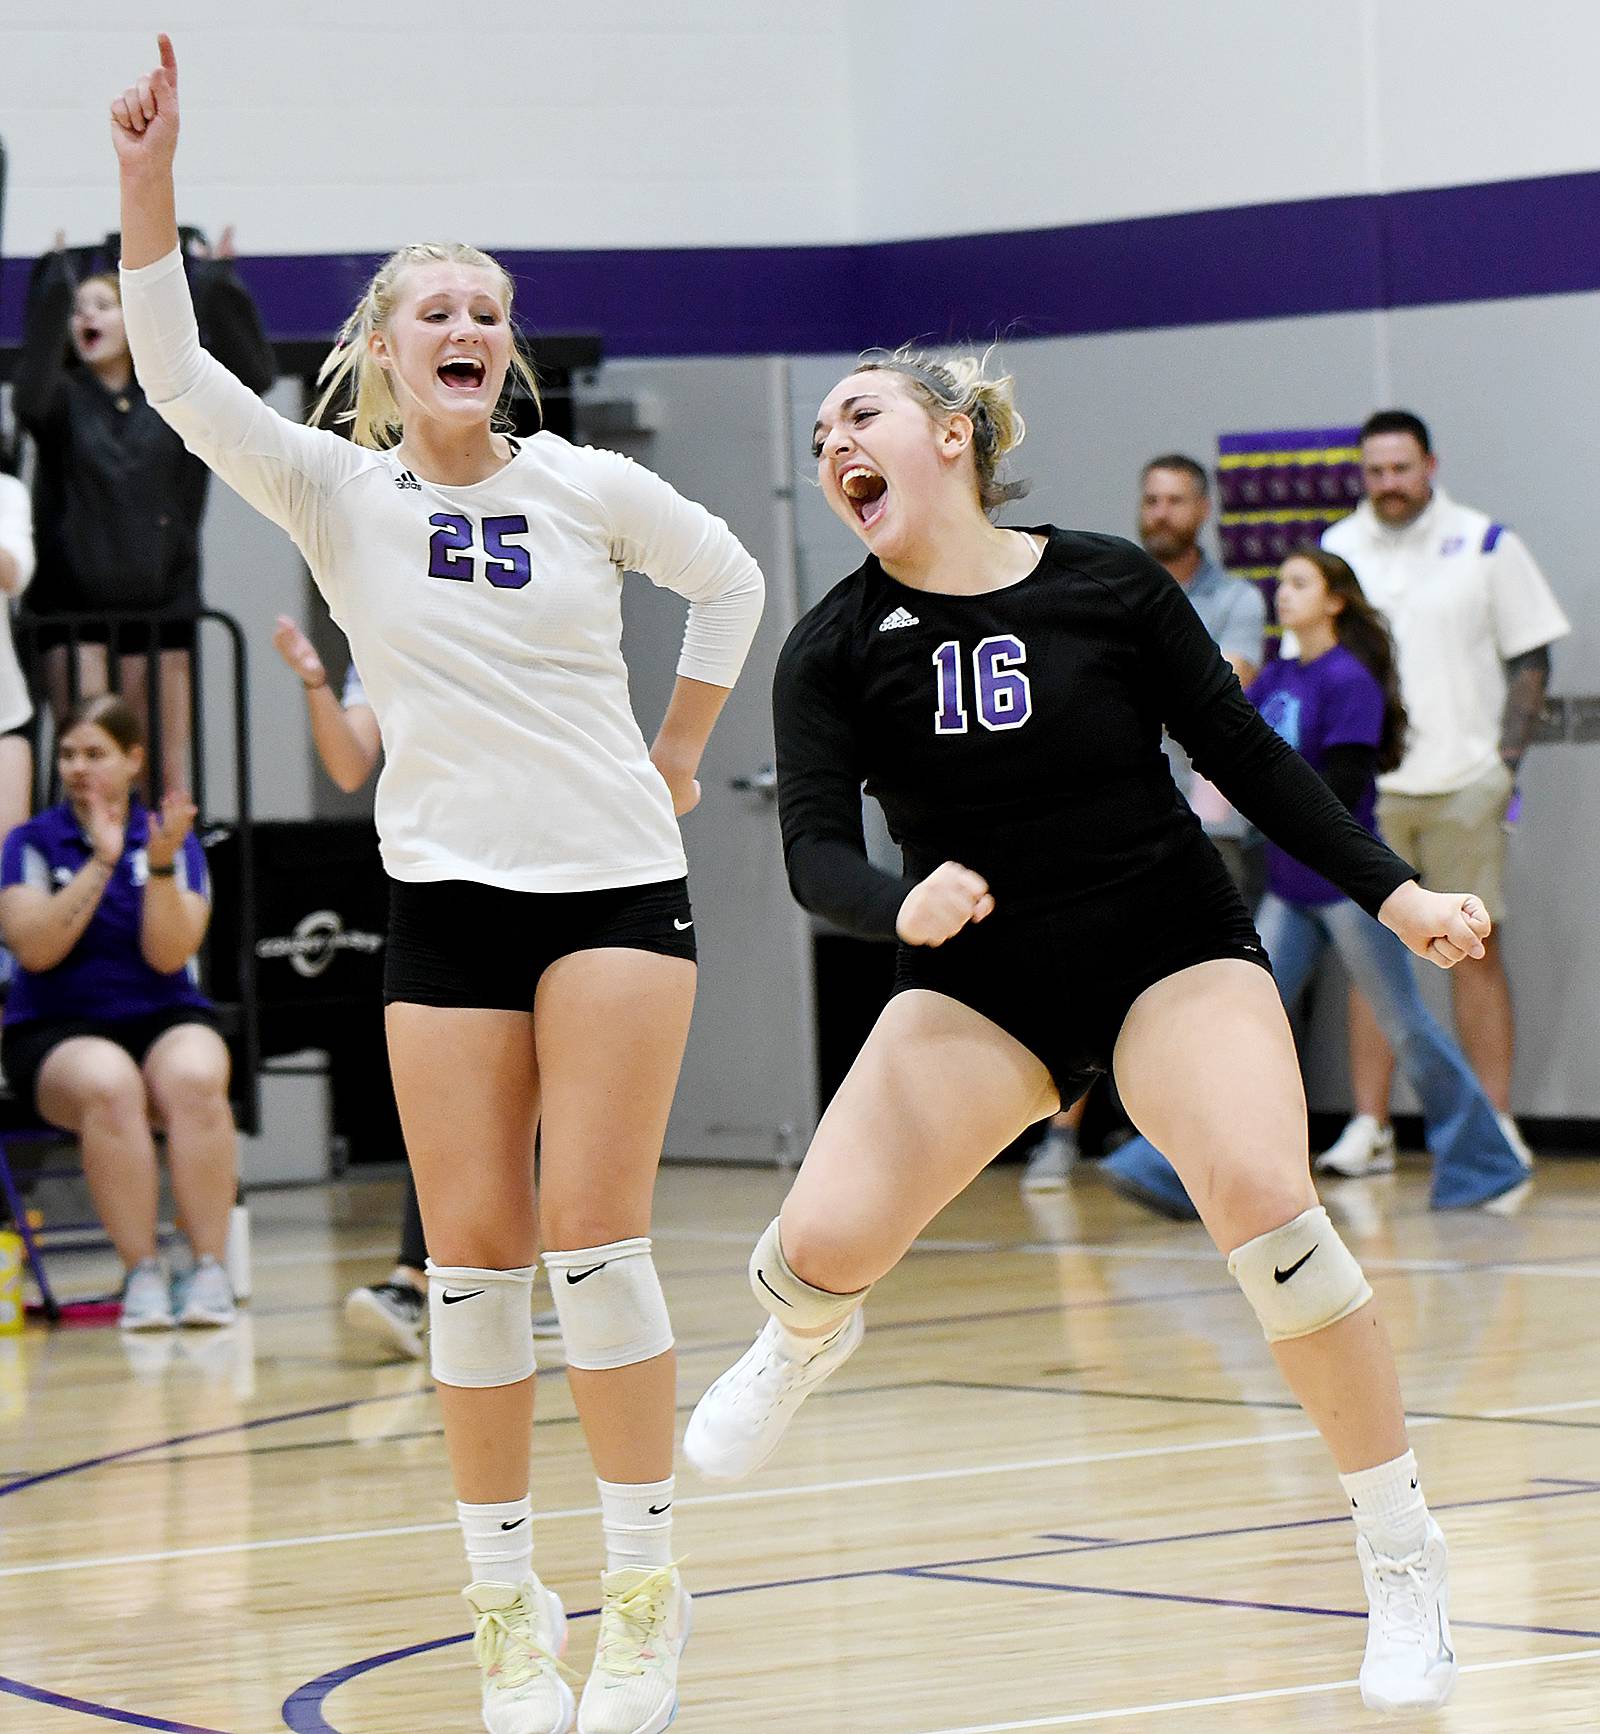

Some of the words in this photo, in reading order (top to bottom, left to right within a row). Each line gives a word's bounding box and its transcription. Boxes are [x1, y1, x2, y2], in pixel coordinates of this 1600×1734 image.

[428, 512, 532, 589] 25
[879, 617, 920, 632] adidas
[932, 634, 1033, 735] 16
